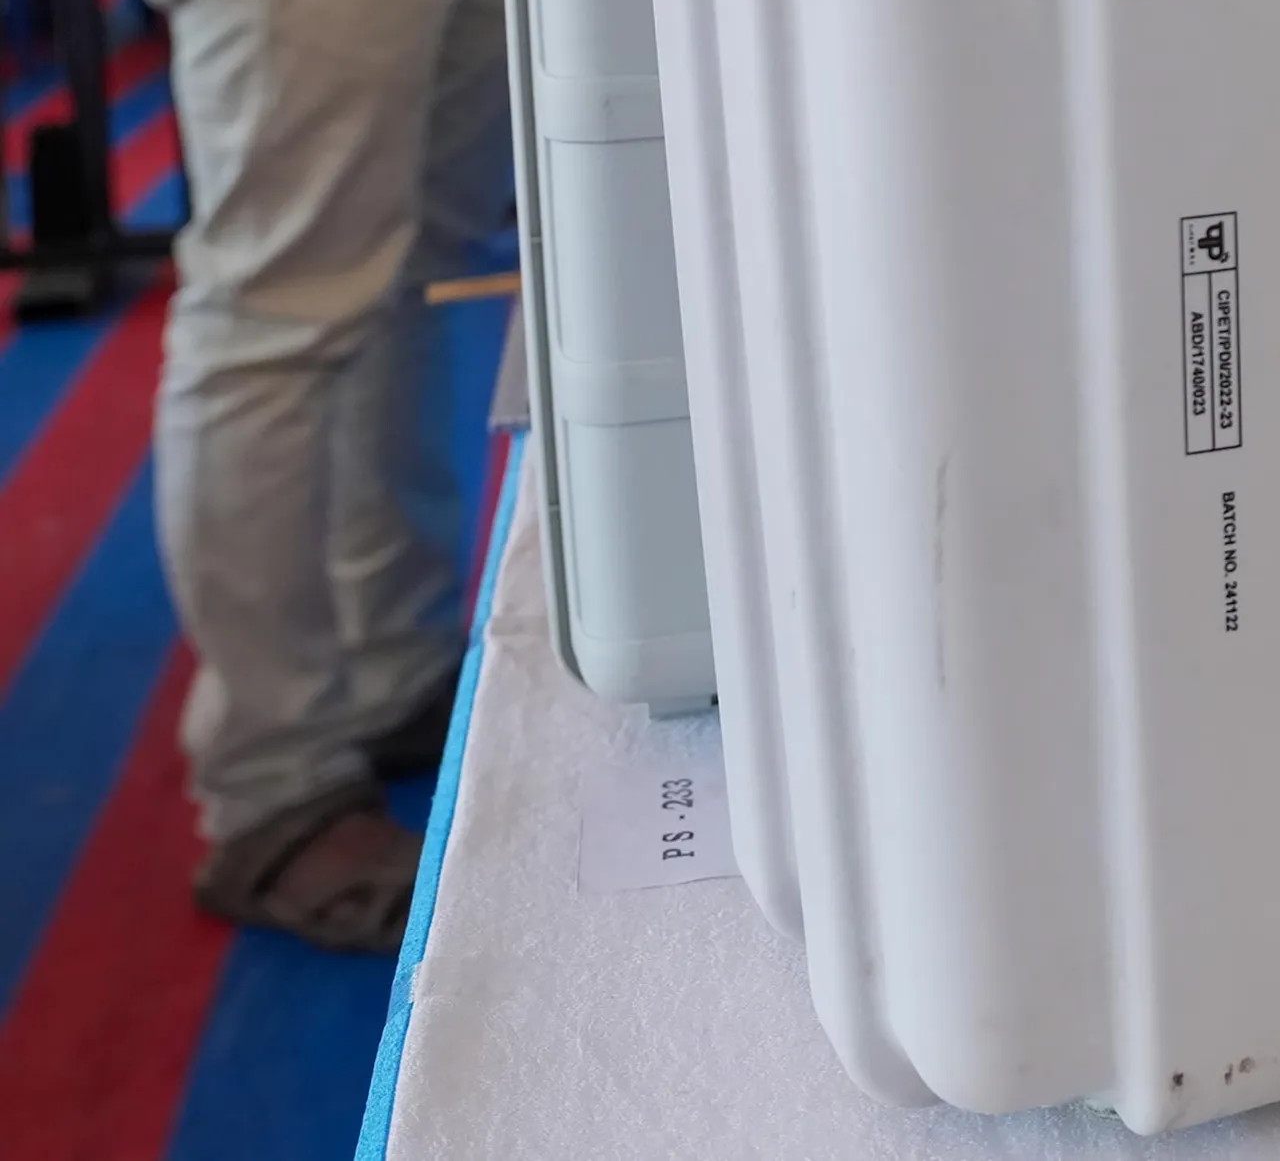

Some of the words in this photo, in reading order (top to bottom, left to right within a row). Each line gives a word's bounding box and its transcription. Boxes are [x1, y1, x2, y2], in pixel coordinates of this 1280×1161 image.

[1222, 491, 1236, 546] BATCH
[1224, 549, 1237, 577] NO.
[1225, 581, 1239, 632] 241122
